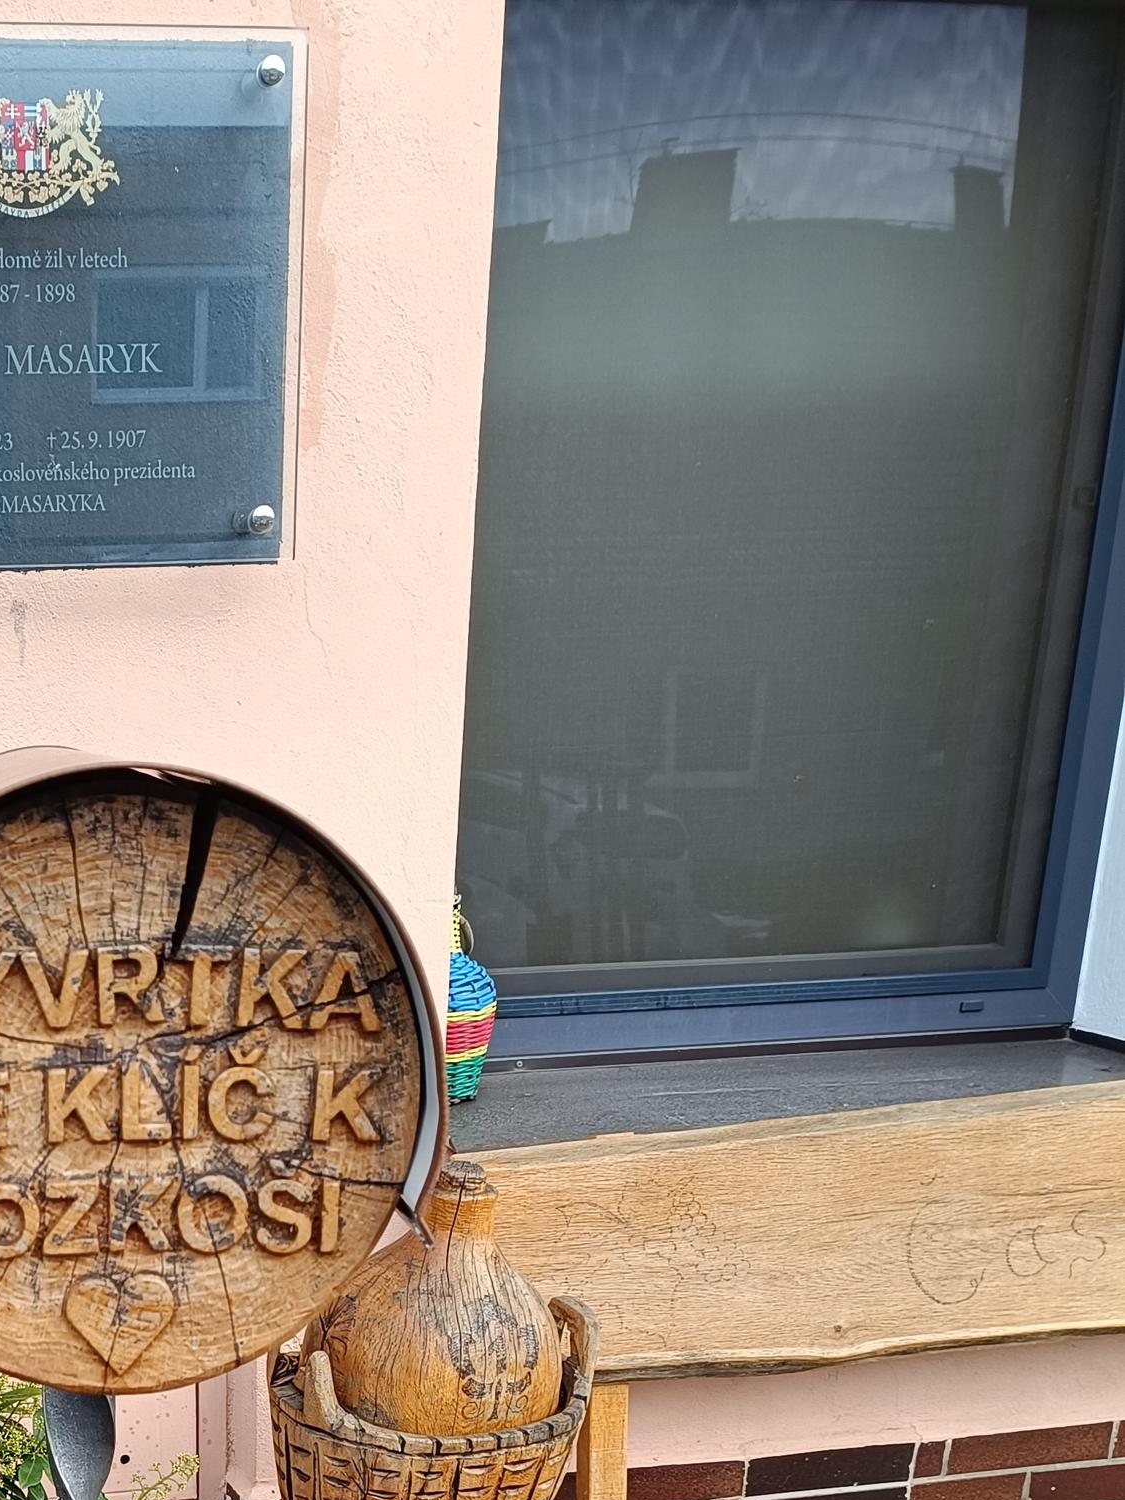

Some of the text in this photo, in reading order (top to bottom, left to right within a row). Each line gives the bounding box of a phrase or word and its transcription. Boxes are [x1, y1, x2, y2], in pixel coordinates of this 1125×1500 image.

[45, 248, 63, 268] žil
[66, 255, 77, 267] v
[80, 247, 128, 268] letech
[35, 283, 76, 303] 1898
[4, 343, 163, 375] MASARYK
[113, 459, 196, 487] prezidenta
[1, 493, 107, 513] MASARYKA
[45, 1042, 277, 1144] KLÍČ
[311, 1067, 381, 1142] K
